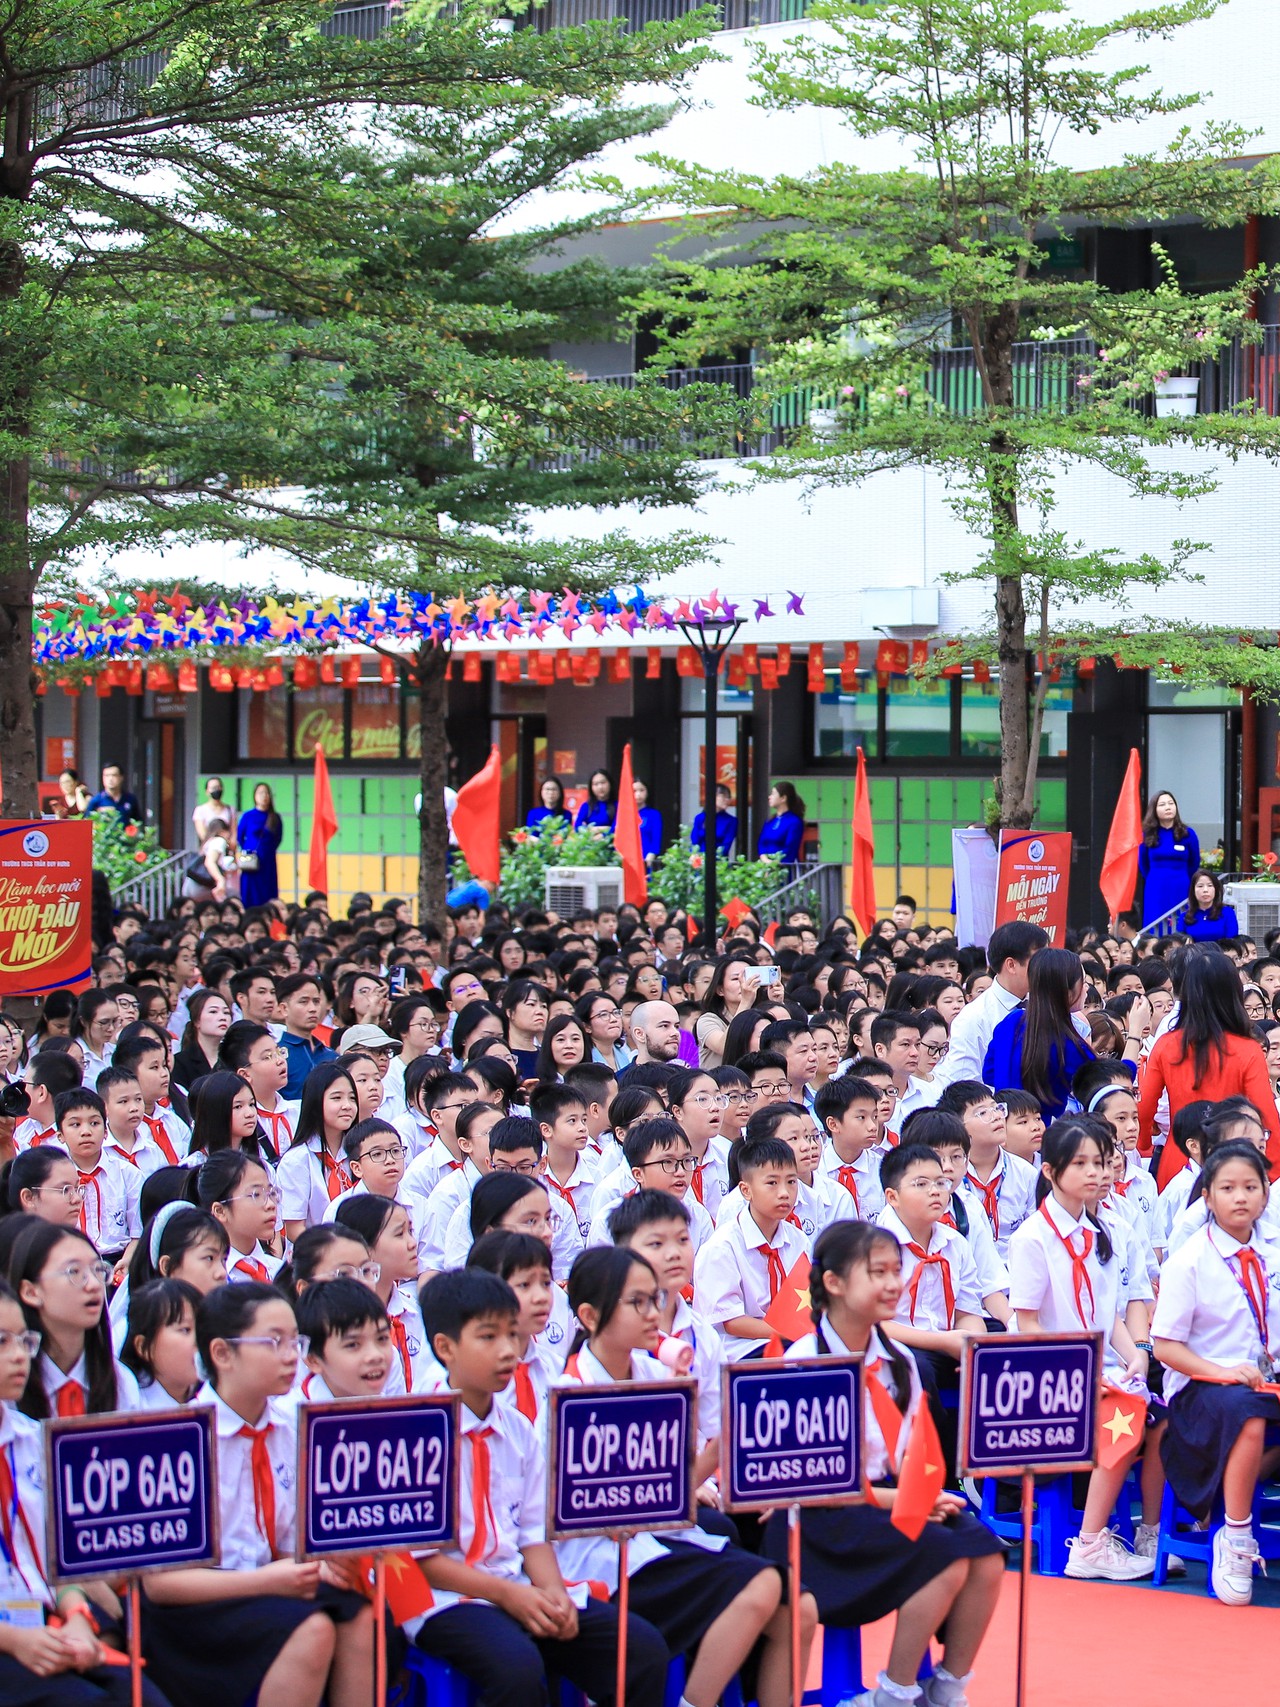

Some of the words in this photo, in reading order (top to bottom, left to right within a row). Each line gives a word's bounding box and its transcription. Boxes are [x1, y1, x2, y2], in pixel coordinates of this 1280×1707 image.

[34, 875, 56, 897] học
[57, 878, 82, 893] mới
[1007, 875, 1029, 902] MỖI
[1030, 872, 1060, 896] NGÀY
[38, 894, 81, 929] ĐẦU
[9, 928, 59, 963] MỚI
[978, 1359, 1034, 1417] LỚP
[1038, 1368, 1085, 1415] 6A8
[739, 1388, 790, 1449] LỚP
[794, 1394, 849, 1446] 6A10
[566, 1411, 620, 1475] LỚP
[625, 1419, 680, 1471] 6A11
[985, 1428, 1042, 1449] CLASS
[1044, 1426, 1075, 1446] 6A8
[314, 1429, 371, 1494] LỚP
[376, 1436, 443, 1489] 6A12
[745, 1458, 802, 1483] CLASS
[805, 1455, 846, 1478] 6A10
[64, 1446, 130, 1516] LỚP
[137, 1450, 196, 1507] 6A9
[570, 1485, 631, 1510] CLASS
[634, 1482, 673, 1503] 6A11
[320, 1503, 385, 1530] CLASS
[388, 1500, 435, 1525] 6A12
[76, 1523, 146, 1553] CLASS
[150, 1518, 189, 1545] 6A9
